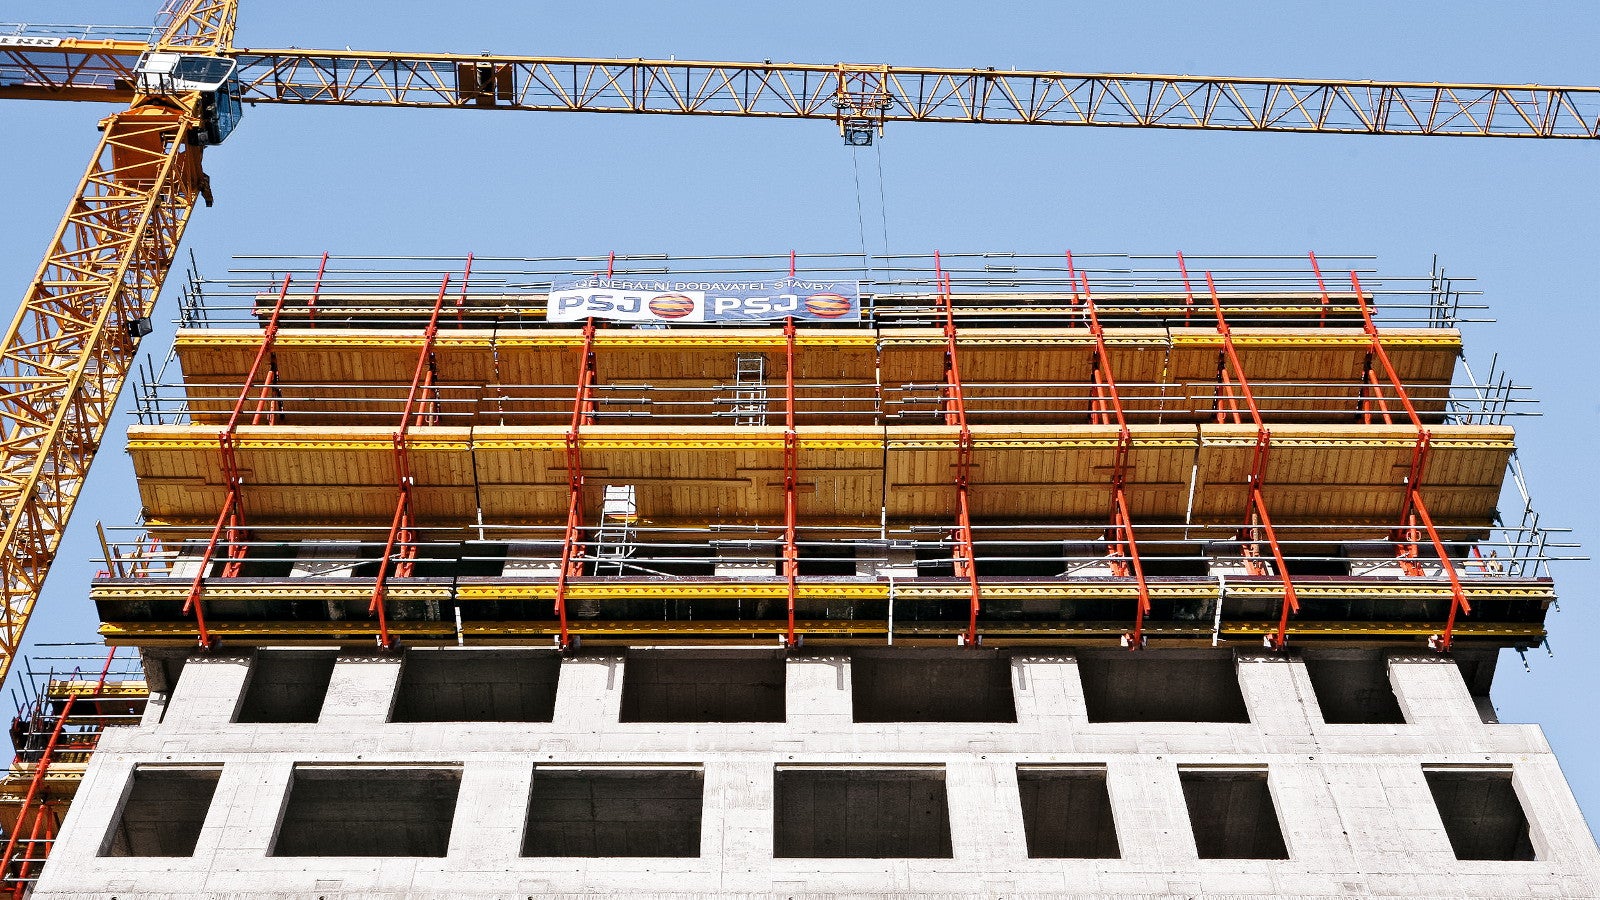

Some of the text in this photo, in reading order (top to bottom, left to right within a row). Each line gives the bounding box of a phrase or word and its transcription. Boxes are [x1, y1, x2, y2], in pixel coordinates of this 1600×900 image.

[675, 281, 769, 291] DODAVATEL
[773, 280, 835, 291] STAVBY
[558, 294, 642, 314] PSJ
[714, 294, 798, 315] PSJ
